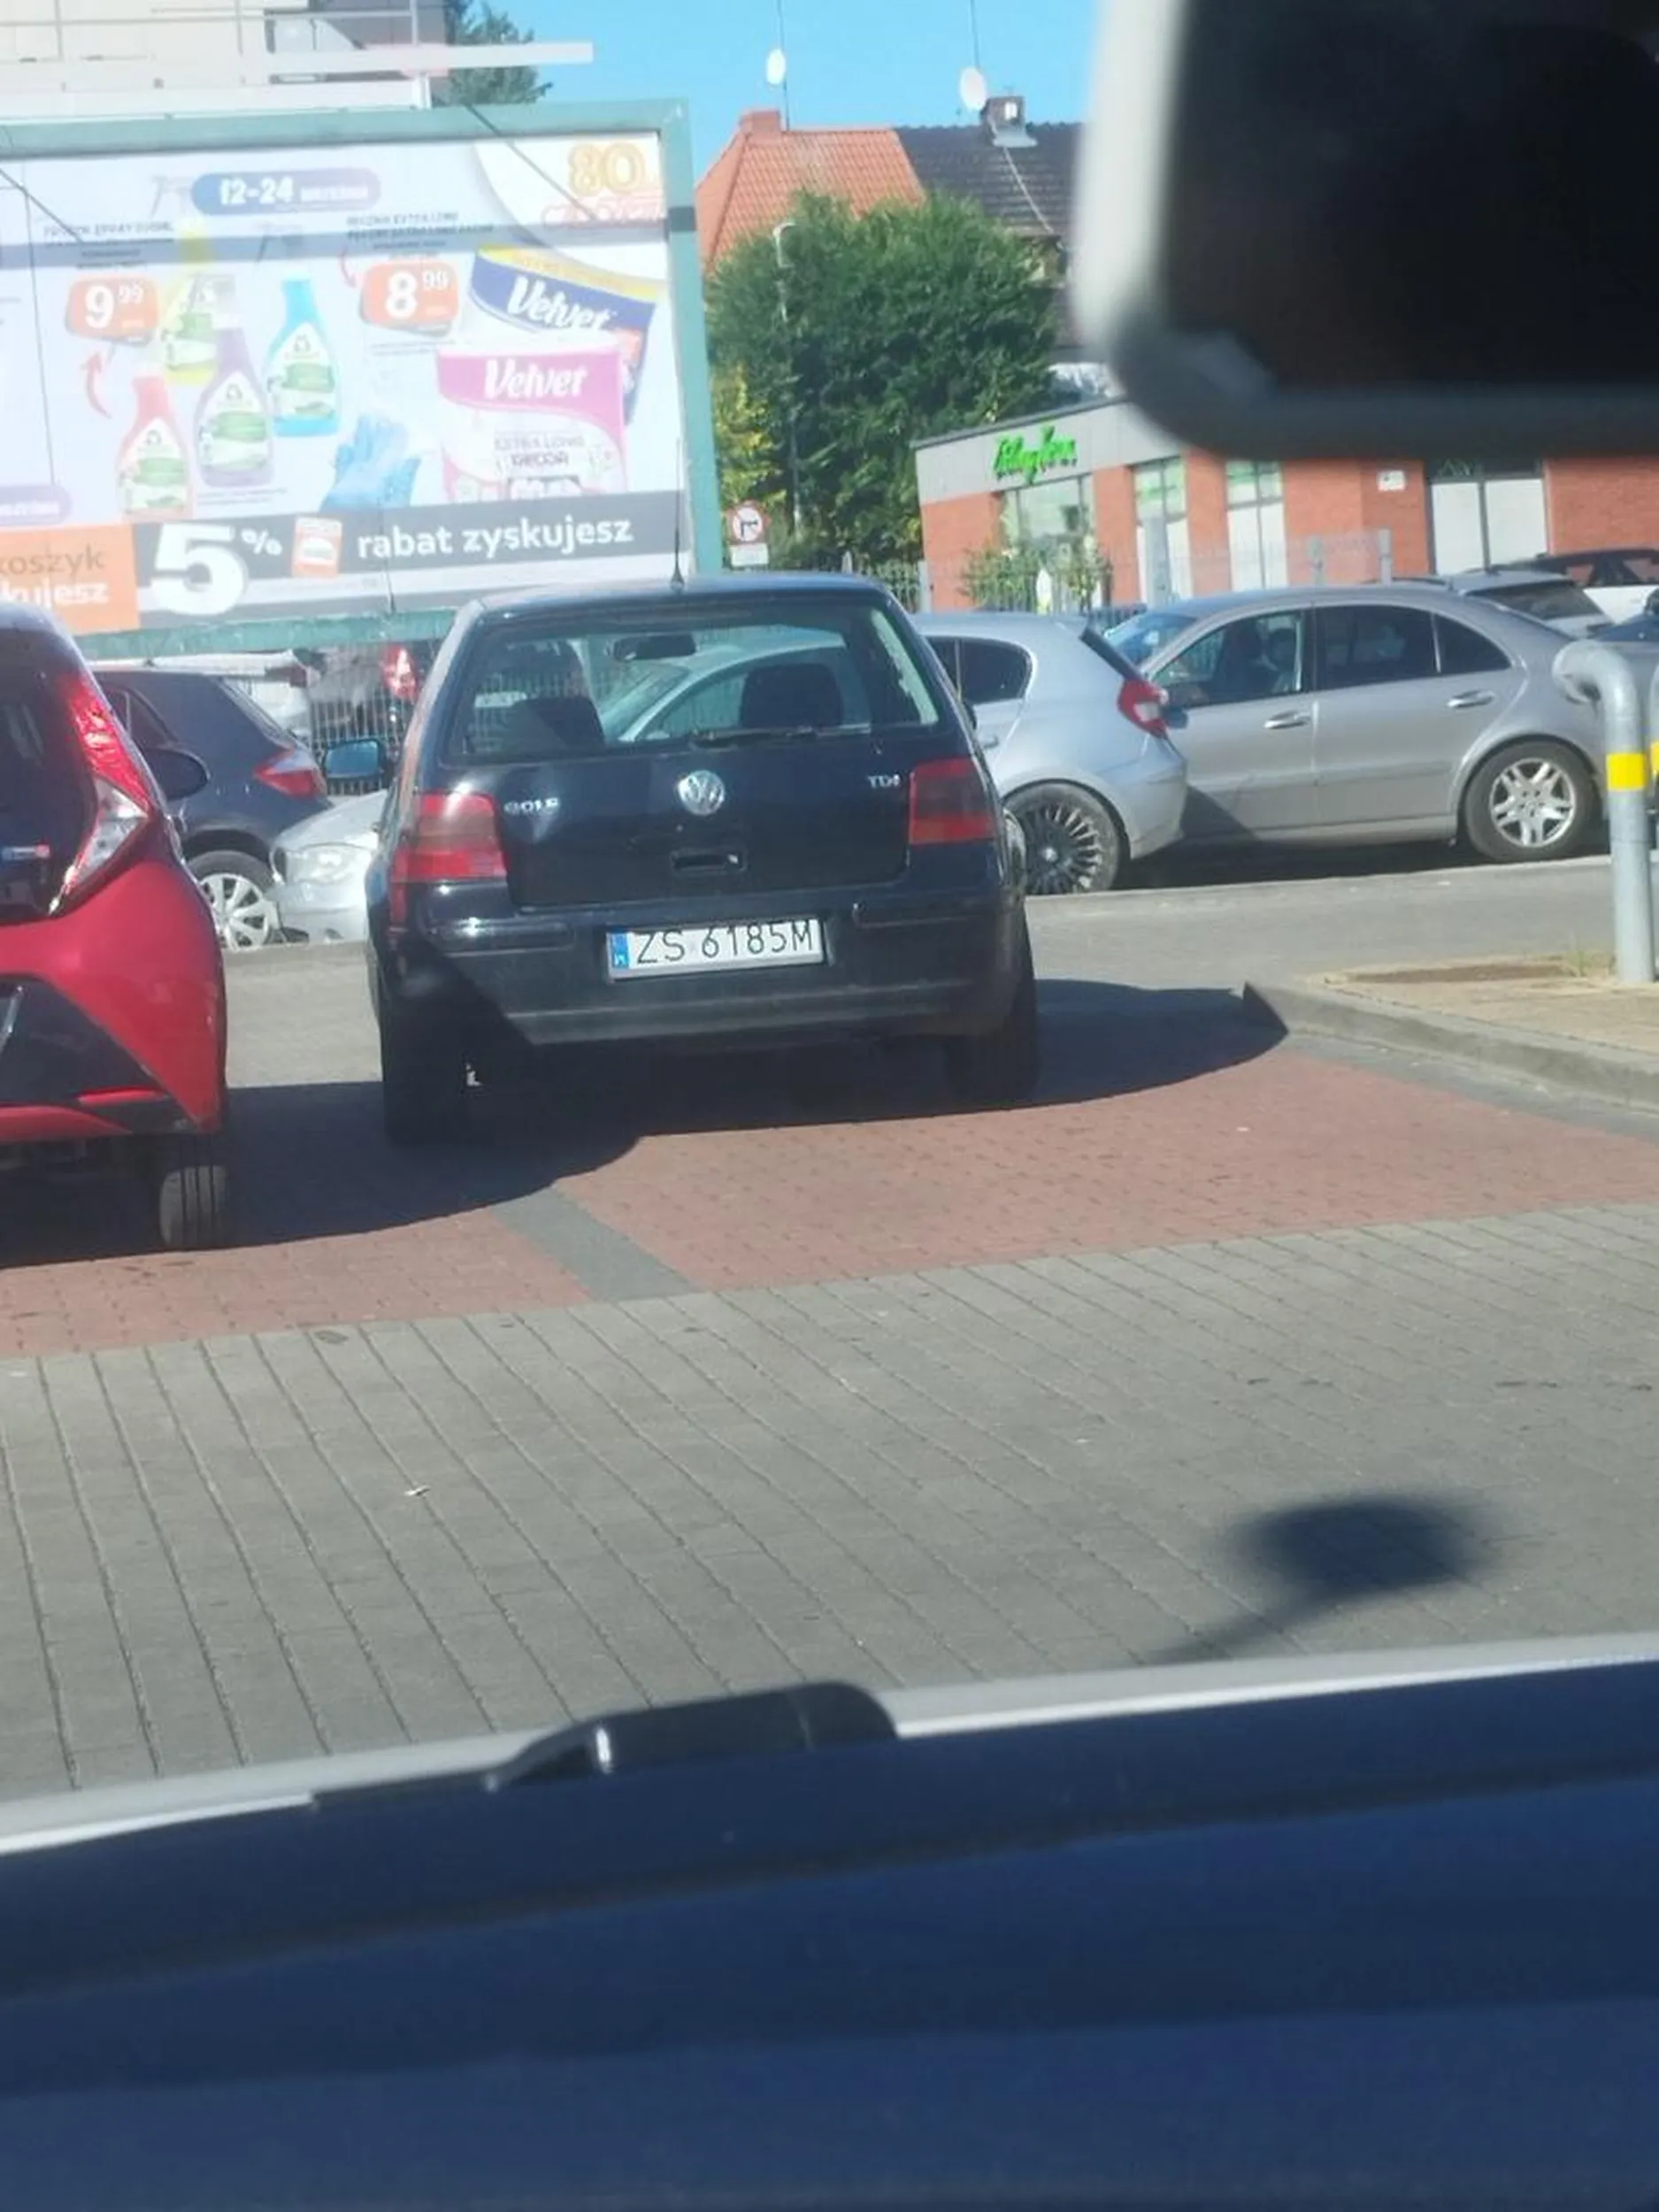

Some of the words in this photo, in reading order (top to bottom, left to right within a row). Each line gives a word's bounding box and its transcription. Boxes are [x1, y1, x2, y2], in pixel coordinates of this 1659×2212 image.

[219, 176, 294, 205] 12-24
[567, 142, 646, 196] 80
[84, 285, 114, 329] 9
[385, 270, 419, 319] 8
[507, 275, 611, 331] Velvet
[485, 357, 588, 398] Velvet
[357, 525, 454, 559] rabat
[461, 513, 634, 559] zyskujesz
[637, 928, 686, 964] ZS
[702, 919, 812, 959] 6185M
